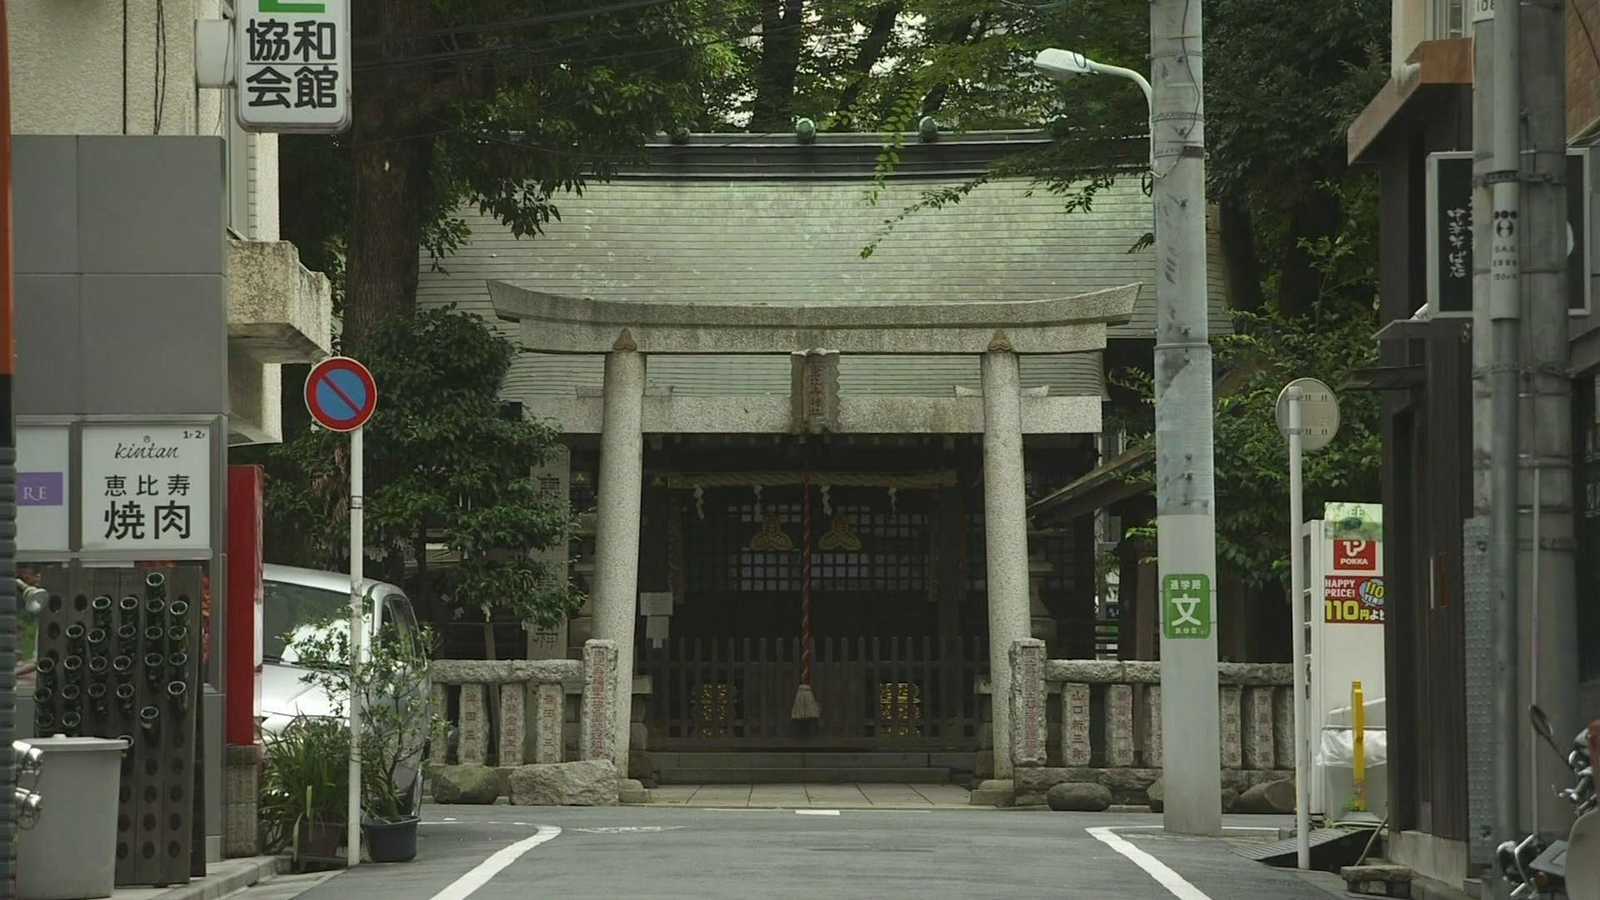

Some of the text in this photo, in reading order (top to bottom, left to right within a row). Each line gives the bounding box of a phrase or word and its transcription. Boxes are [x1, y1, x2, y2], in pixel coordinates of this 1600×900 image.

[246, 18, 336, 62] 協和
[246, 65, 338, 109] 会館
[114, 442, 180, 459] kintan
[104, 474, 191, 497] 恵比寿
[104, 500, 191, 540] 焼肉
[1341, 557, 1369, 566] POKKA
[1170, 579, 1201, 590] 通学路
[1325, 579, 1355, 588] HAPPY
[1366, 581, 1384, 598] 110
[1325, 588, 1355, 598] PRICE!
[1171, 593, 1202, 627] 文
